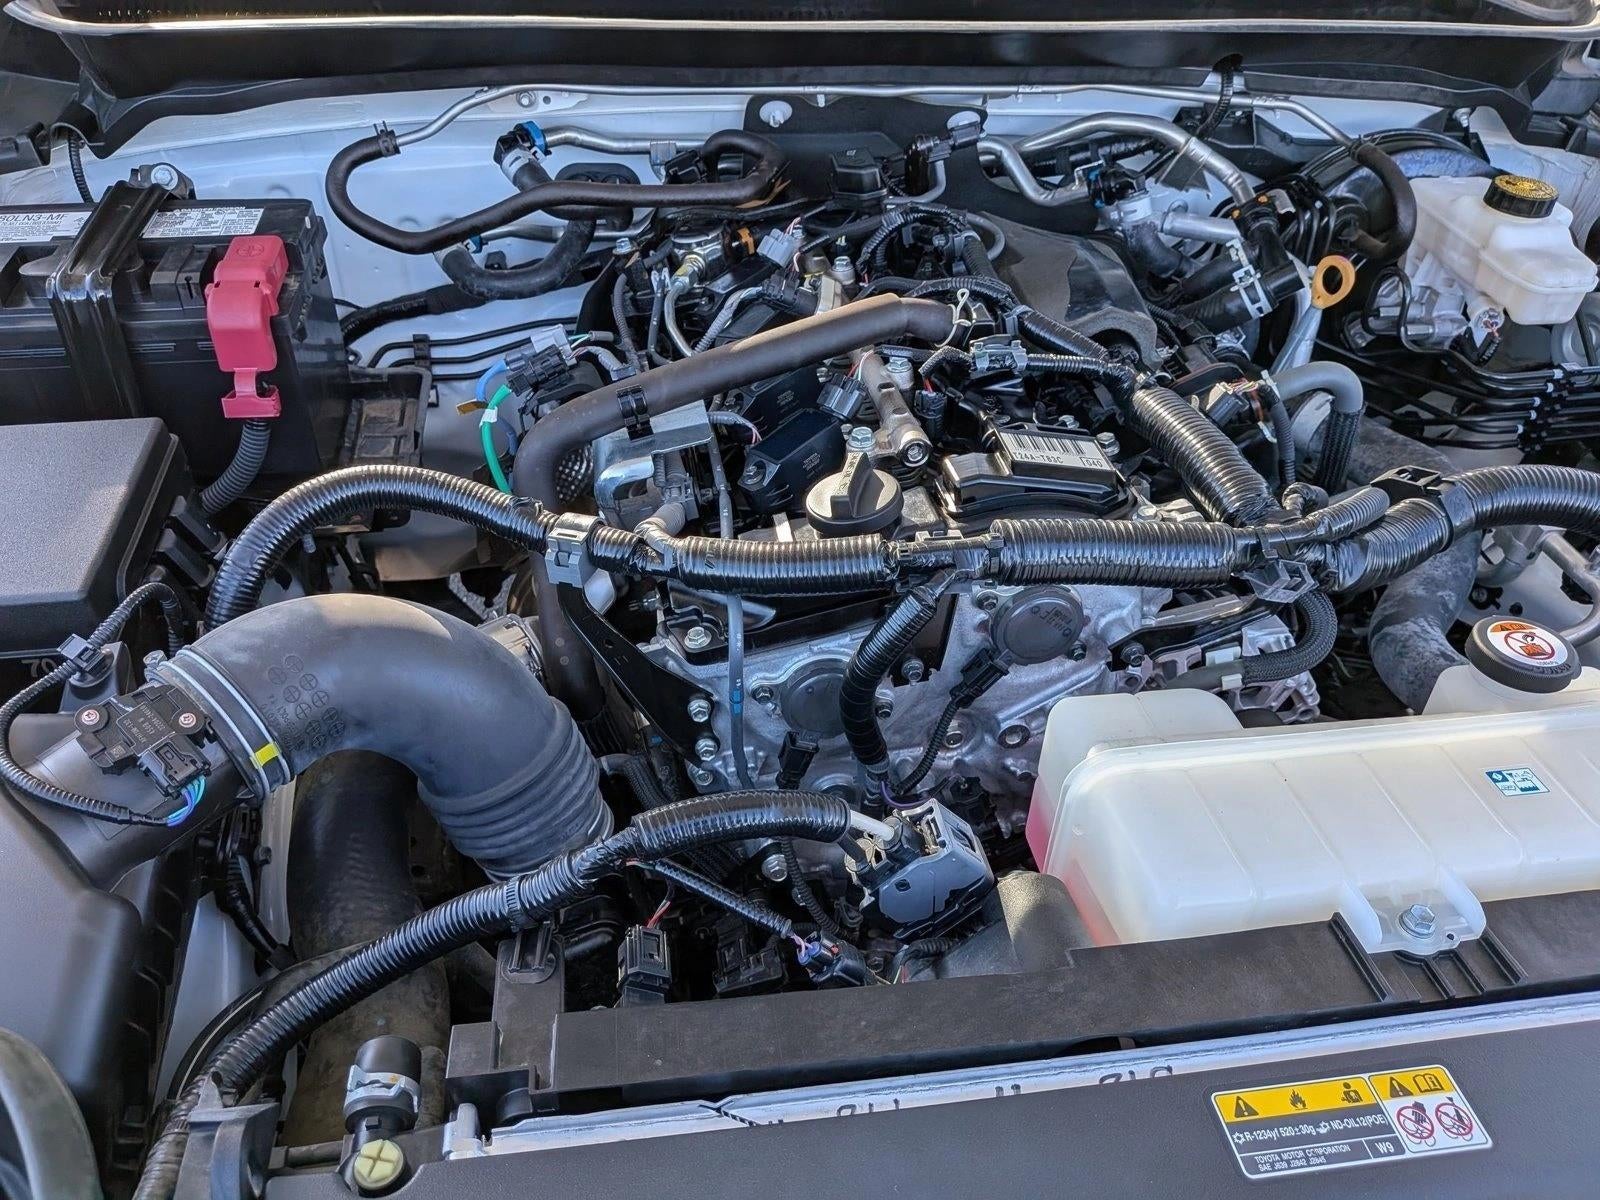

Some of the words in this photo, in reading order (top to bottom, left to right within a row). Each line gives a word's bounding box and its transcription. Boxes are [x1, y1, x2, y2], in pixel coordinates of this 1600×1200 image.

[1244, 1127, 1280, 1141] R-1234yf
[1279, 1123, 1317, 1136] 520±30g
[1374, 1141, 1395, 1154] W9
[1254, 1153, 1280, 1164] TOYOTA
[1281, 1149, 1305, 1160] MOTOR
[1258, 1163, 1272, 1172] SAE
